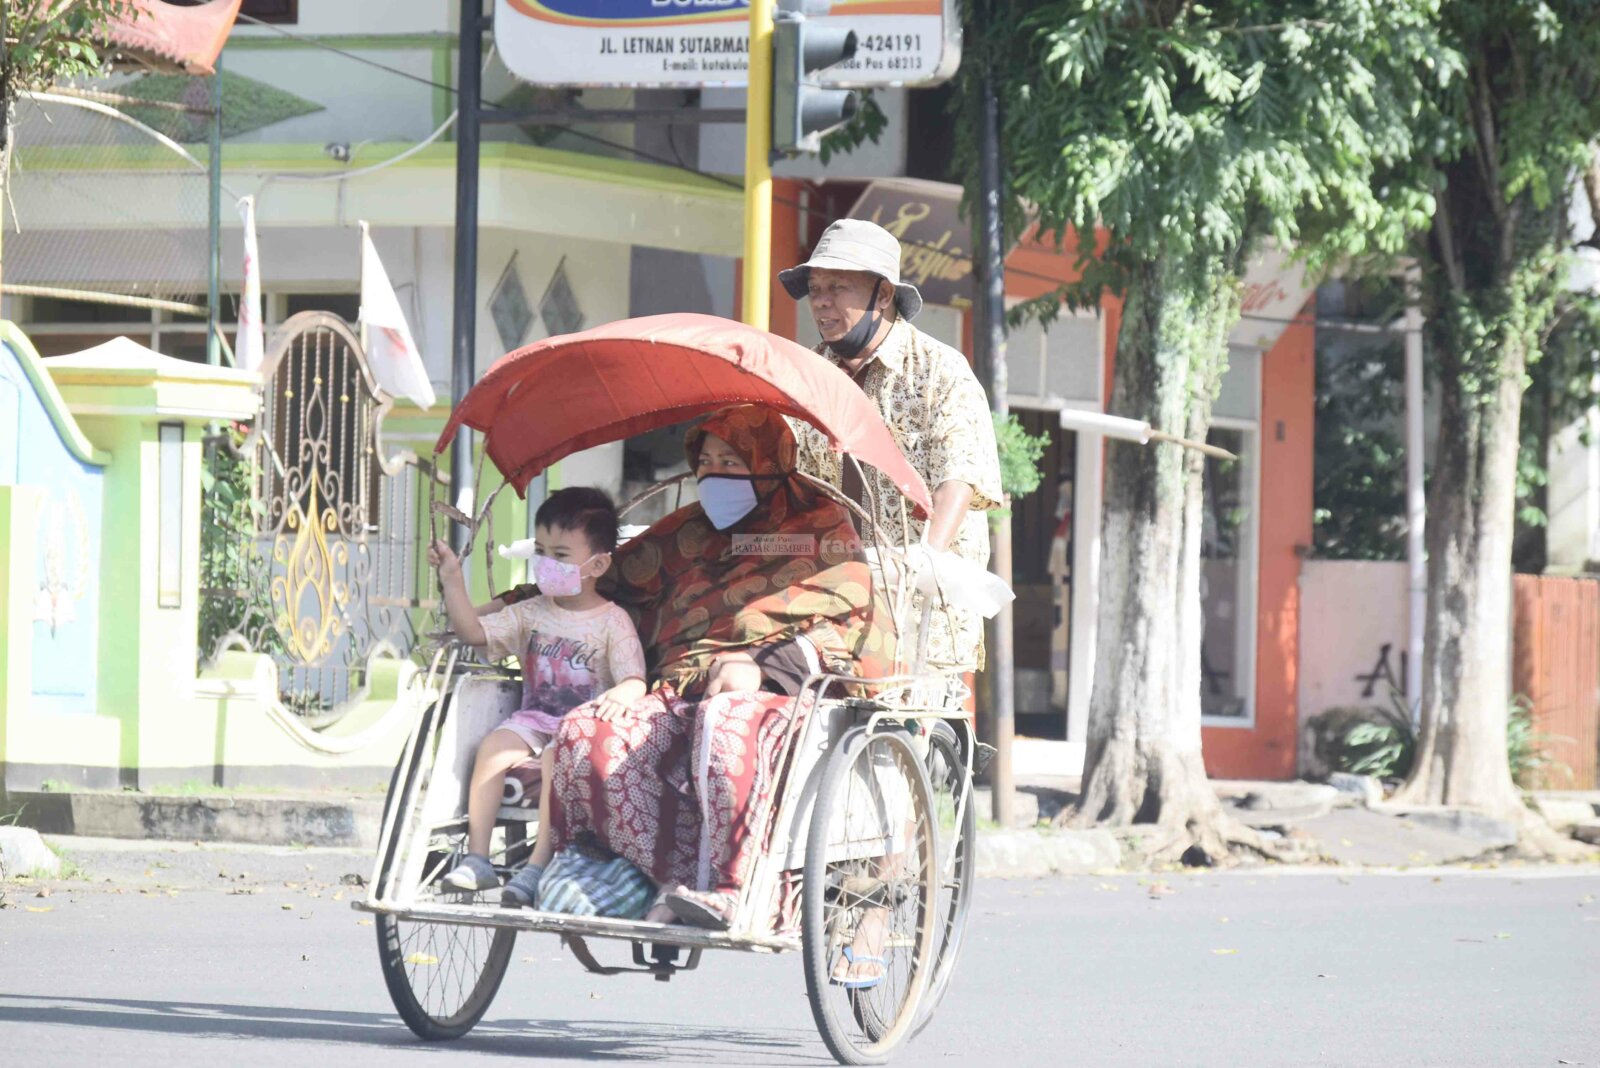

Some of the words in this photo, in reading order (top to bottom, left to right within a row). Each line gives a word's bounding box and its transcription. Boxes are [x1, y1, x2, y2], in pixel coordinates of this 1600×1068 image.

[600, 37, 617, 54] JL.
[623, 37, 674, 54] LETNAN
[857, 34, 921, 51] -424191
[663, 58, 698, 71] E-mail:
[838, 60, 861, 70] ode
[888, 57, 922, 70] 68213
